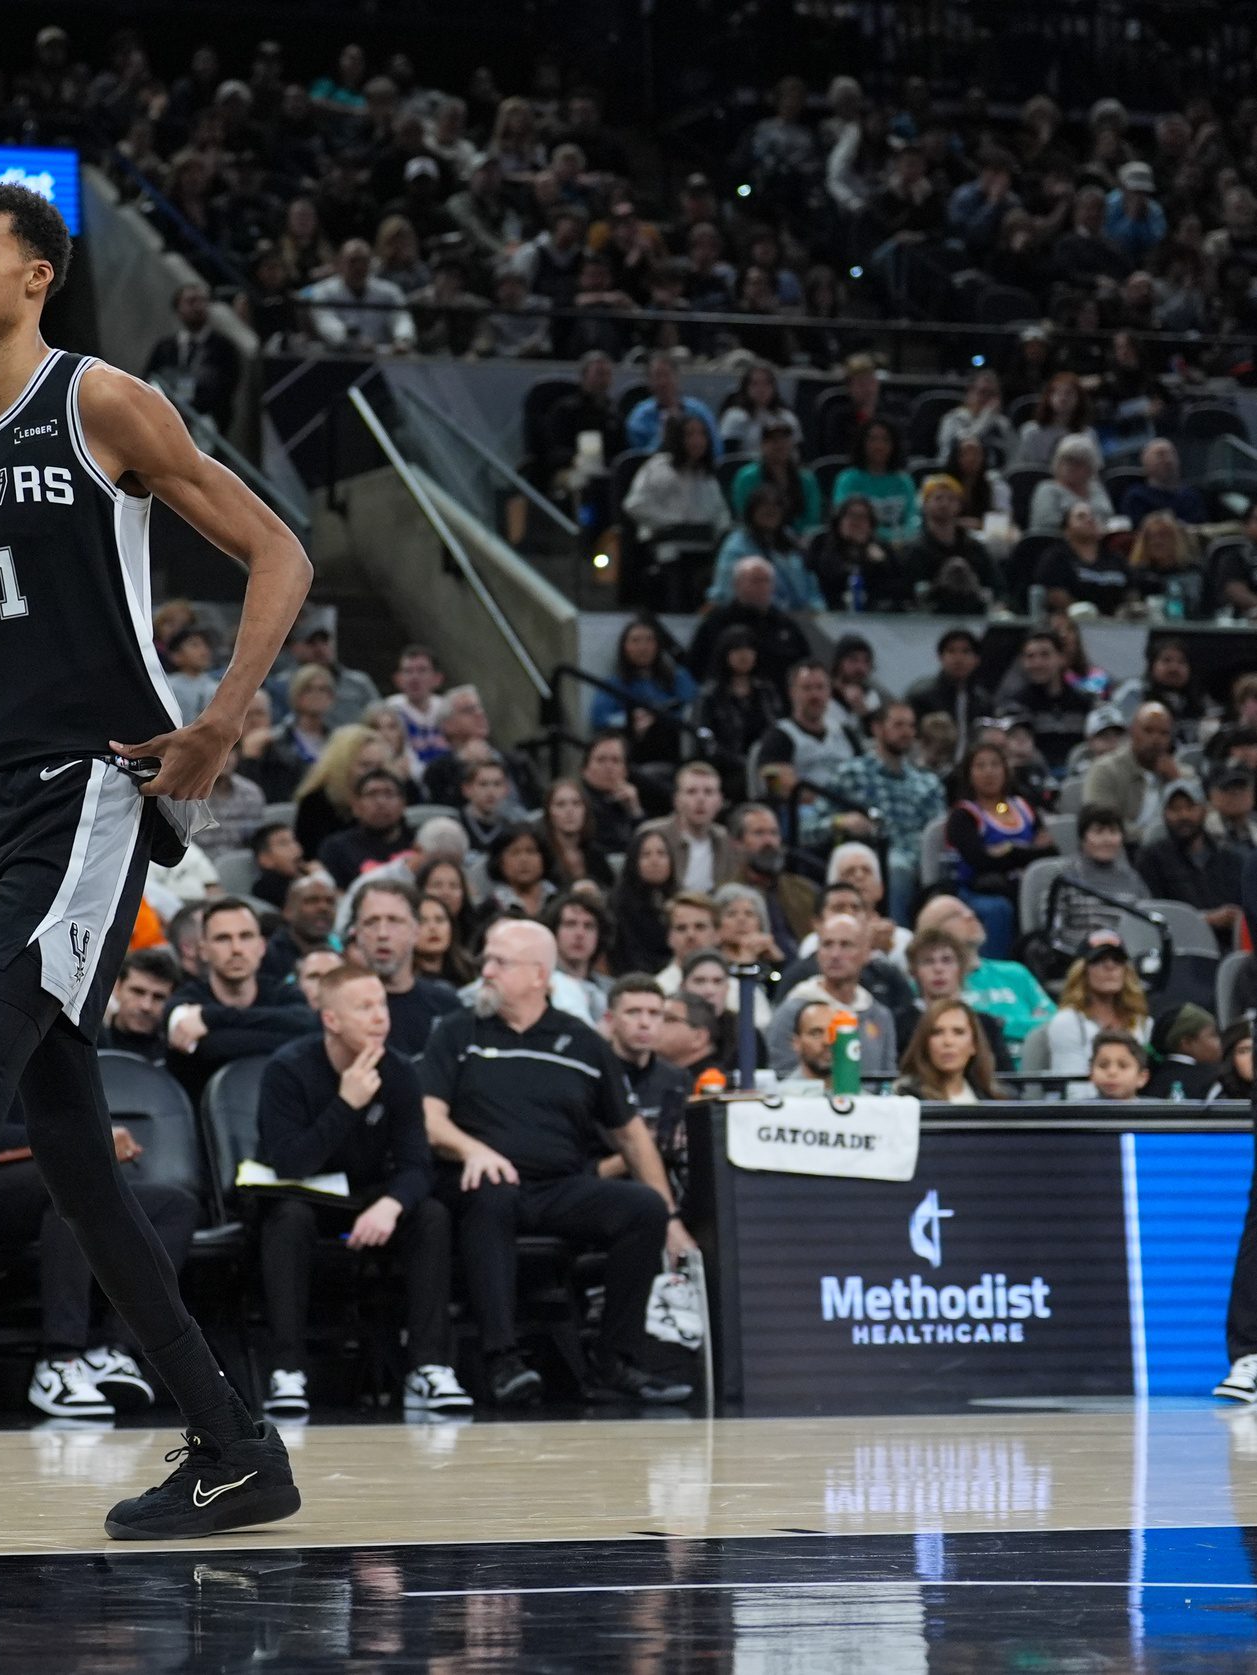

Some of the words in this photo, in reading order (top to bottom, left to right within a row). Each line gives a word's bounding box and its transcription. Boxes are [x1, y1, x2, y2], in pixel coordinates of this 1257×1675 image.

[19, 425, 52, 439] LEDGER
[757, 1126, 876, 1151] GATORADE
[820, 1273, 1052, 1321] Methodist
[852, 1323, 1025, 1345] HEALTHCARE
